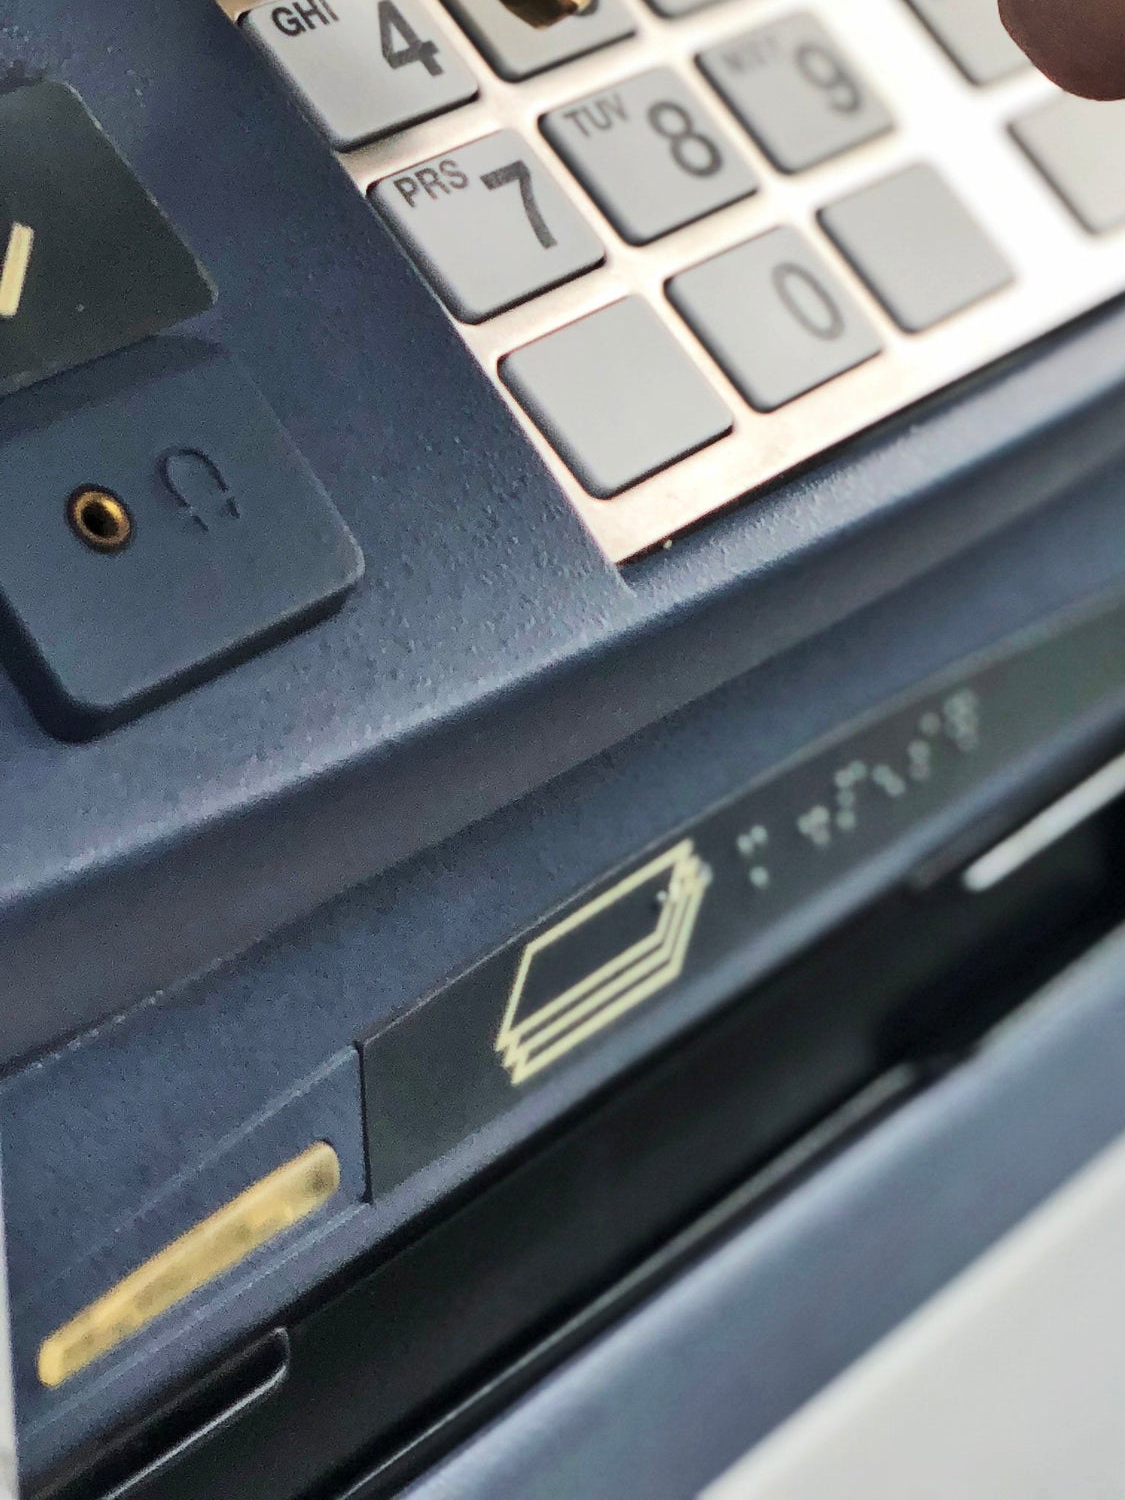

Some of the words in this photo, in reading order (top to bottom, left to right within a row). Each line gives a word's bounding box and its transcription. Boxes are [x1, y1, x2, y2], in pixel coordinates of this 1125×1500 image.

[796, 43, 863, 115] 9
[563, 94, 630, 139] TUV
[646, 100, 723, 178] 8
[392, 158, 469, 208] PRS
[479, 159, 558, 250] 7
